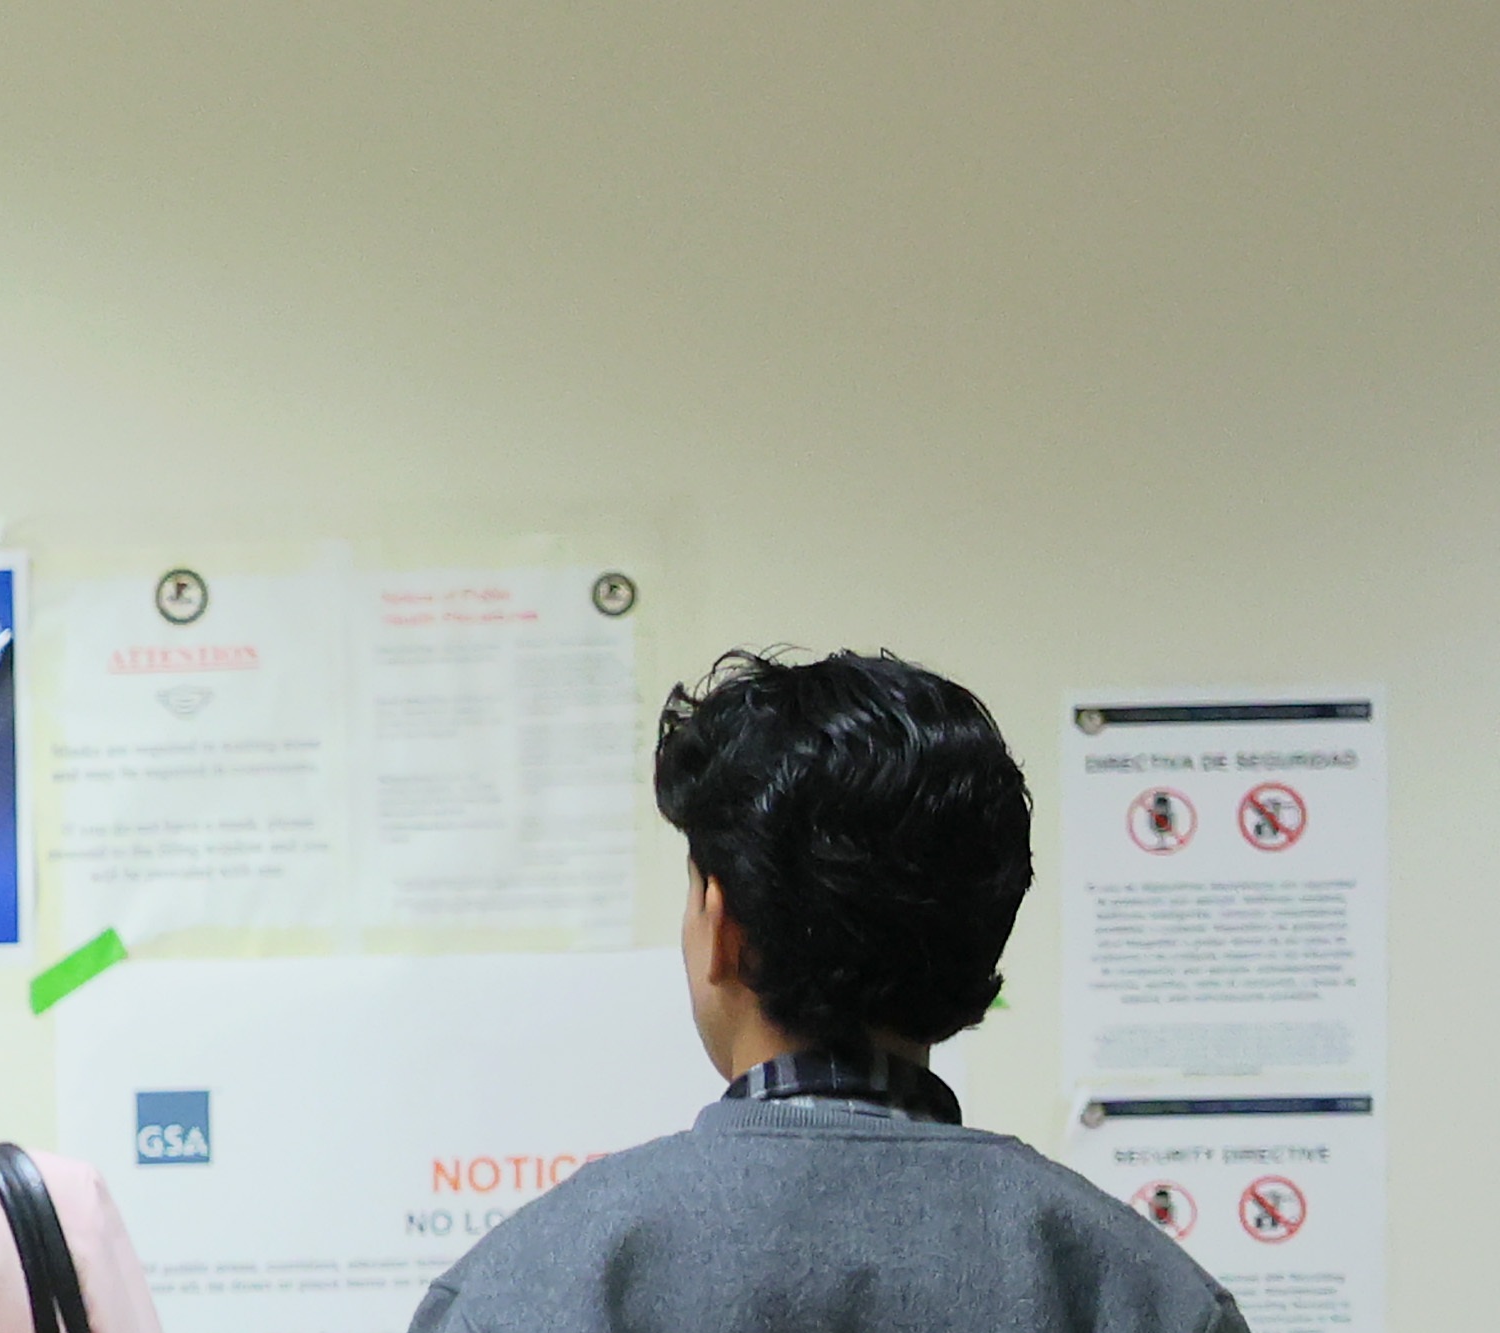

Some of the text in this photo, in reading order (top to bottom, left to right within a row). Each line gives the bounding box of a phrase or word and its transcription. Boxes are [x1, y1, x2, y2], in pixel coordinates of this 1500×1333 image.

[137, 1124, 209, 1158] GSA
[432, 1153, 608, 1193] NOTIC
[406, 1209, 453, 1236] NO
